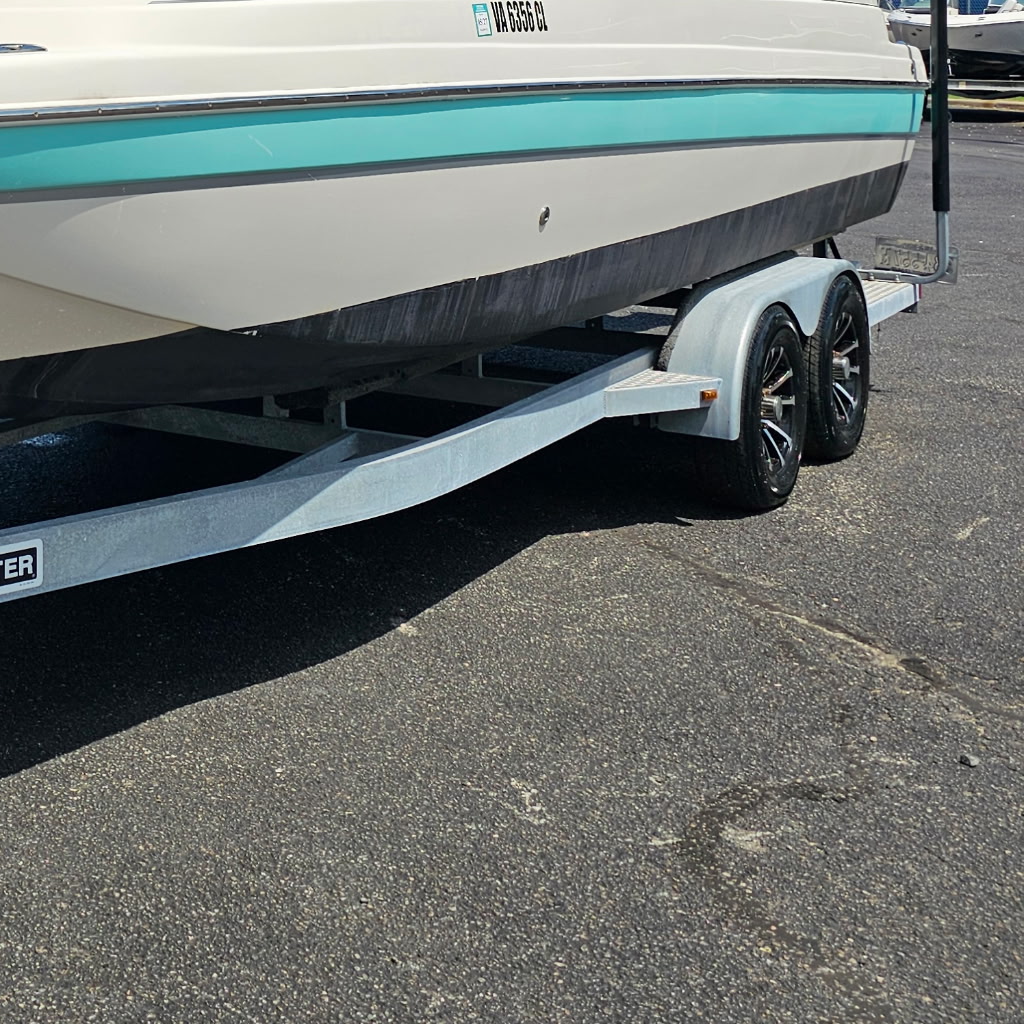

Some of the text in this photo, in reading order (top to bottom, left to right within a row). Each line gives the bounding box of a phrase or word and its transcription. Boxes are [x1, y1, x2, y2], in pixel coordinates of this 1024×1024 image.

[490, 0, 548, 33] VA 6356 CL
